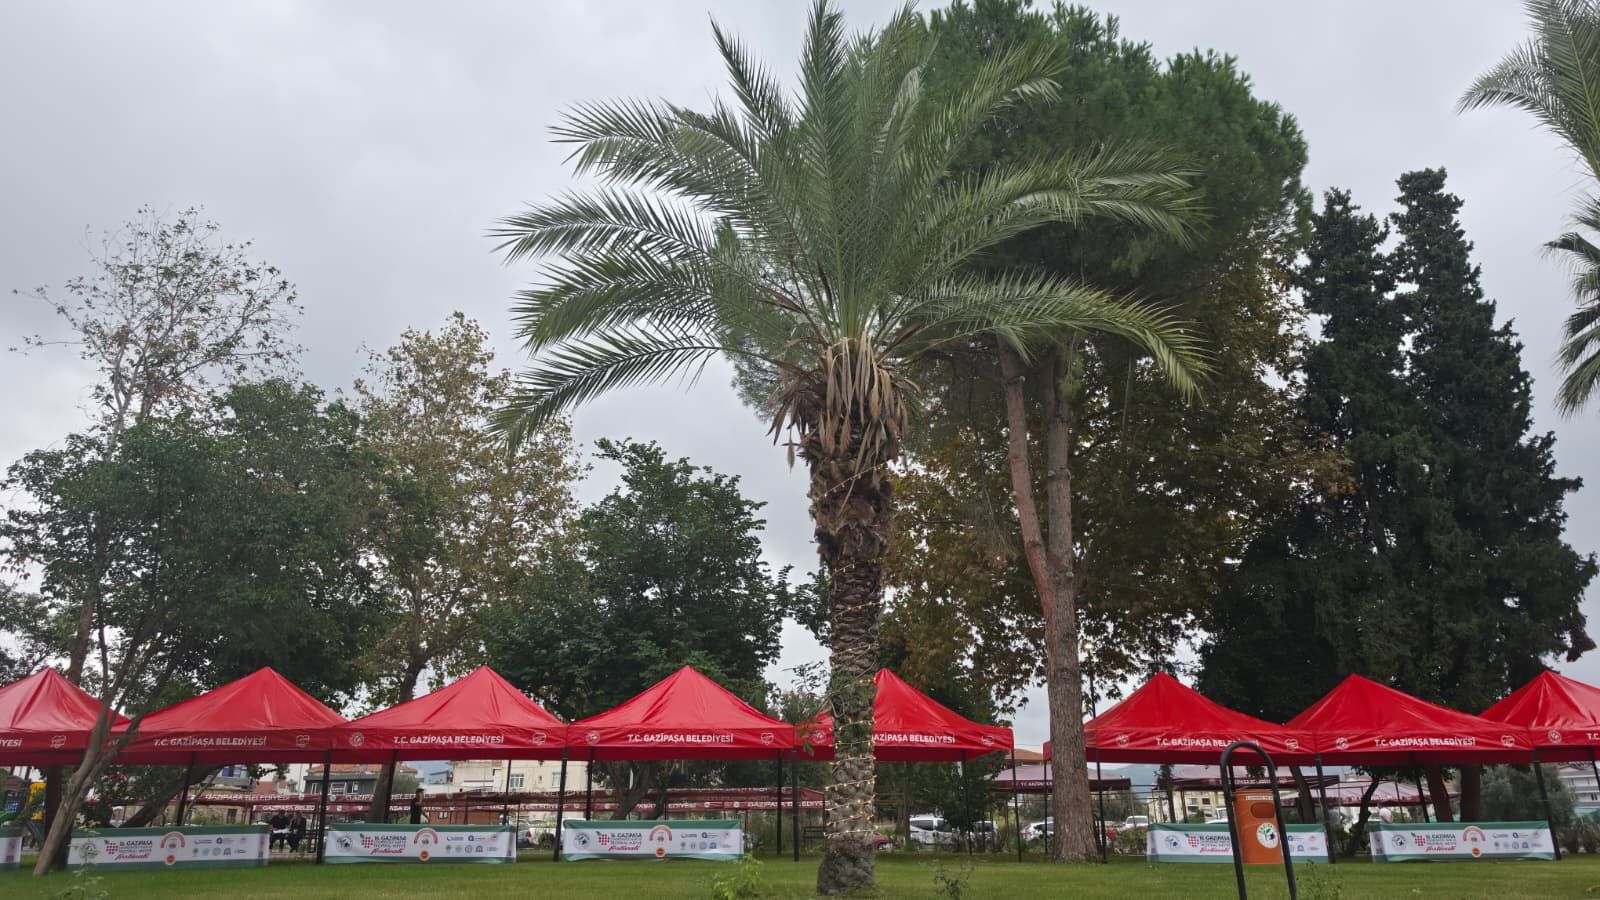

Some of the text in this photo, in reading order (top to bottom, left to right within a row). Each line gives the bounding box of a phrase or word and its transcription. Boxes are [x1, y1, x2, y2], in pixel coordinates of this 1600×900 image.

[154, 736, 267, 748] T.C. GAZİPAŞA BELEDİYESİ
[394, 734, 505, 745] T.C. GAZİPAŞA BELEDİYESİ
[628, 732, 734, 743] T.C. GAZİPAŞA BELEDİYESİ
[909, 733, 956, 744] BELEDİYESİ
[1156, 738, 1170, 746] T.C.
[1171, 737, 1212, 748] GAZİPAŞA
[1375, 736, 1476, 748] T.C. GAZİPAŞA BELEDİYESİ
